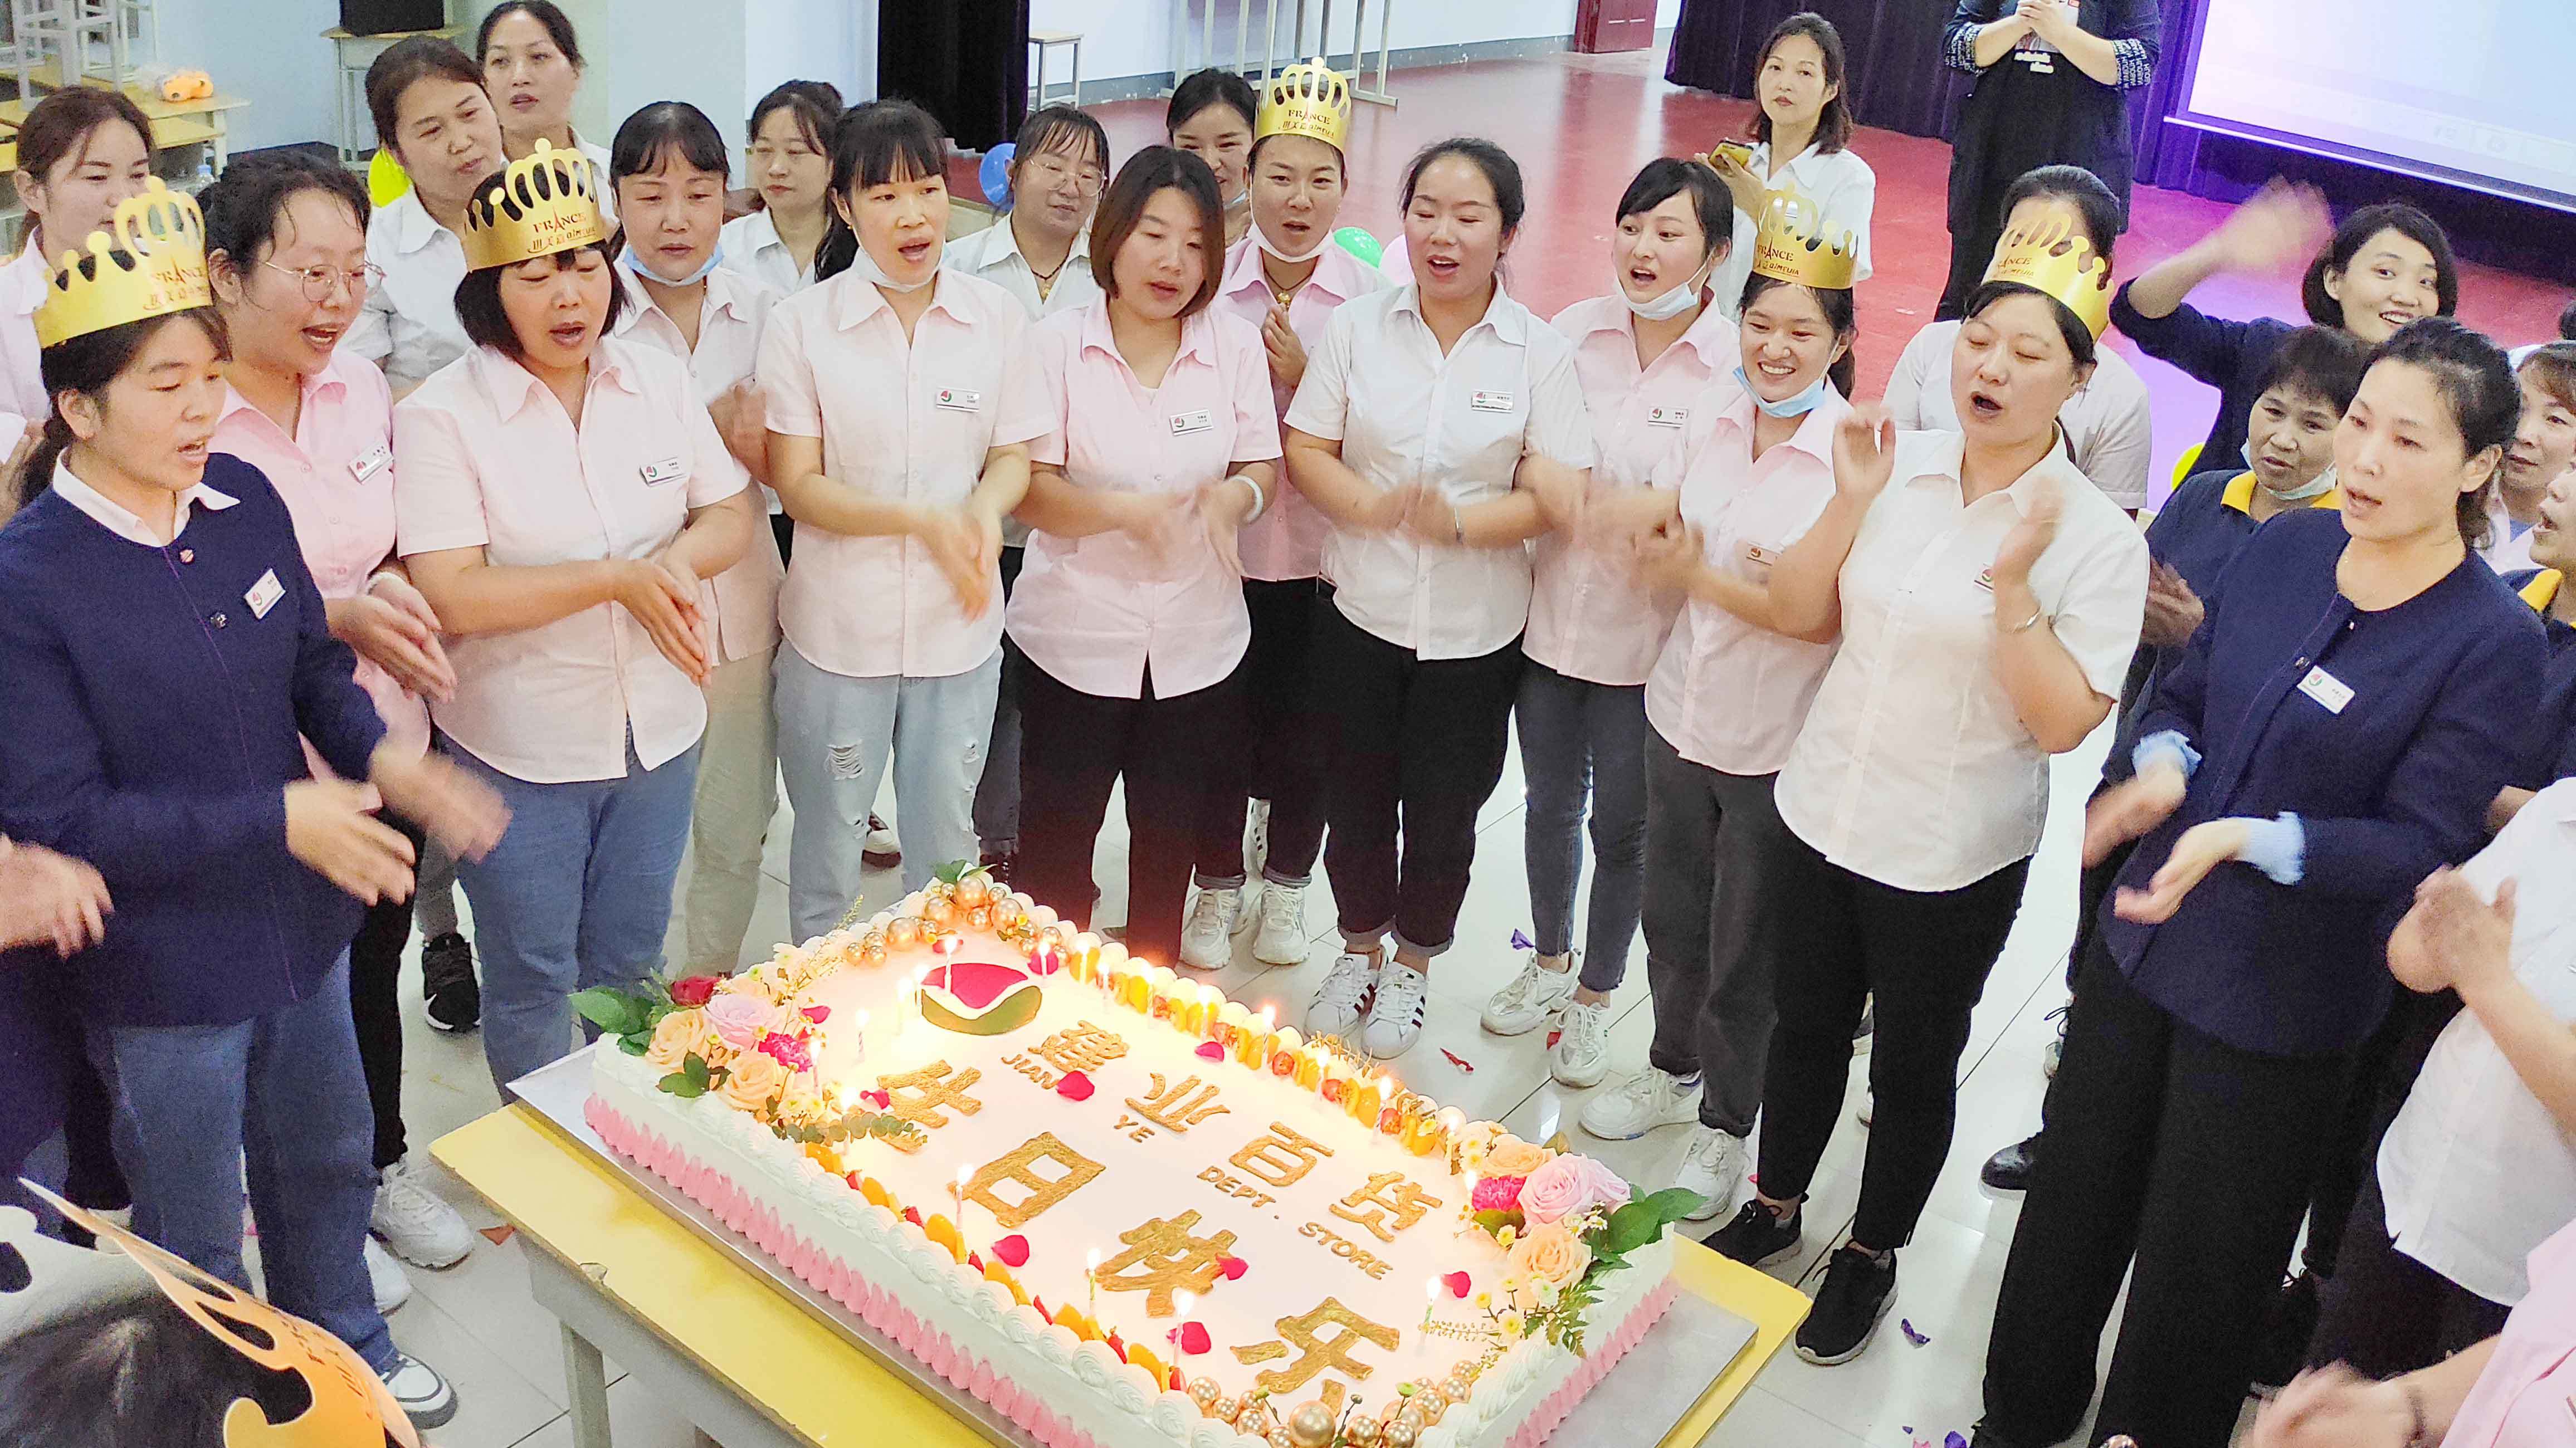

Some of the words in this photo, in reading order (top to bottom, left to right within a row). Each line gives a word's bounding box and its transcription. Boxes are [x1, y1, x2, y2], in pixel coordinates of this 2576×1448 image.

[1289, 102, 1331, 125] FRANCE
[533, 206, 587, 233] FRANCE
[1758, 237, 1794, 261] FRANCE
[1001, 1054, 1060, 1089] JIAN
[1114, 1114, 1155, 1143] YE
[1298, 1222, 1394, 1280] STORE
[1027, 1020, 1444, 1242] 建业百货
[877, 1059, 1401, 1417] 生日快乐
